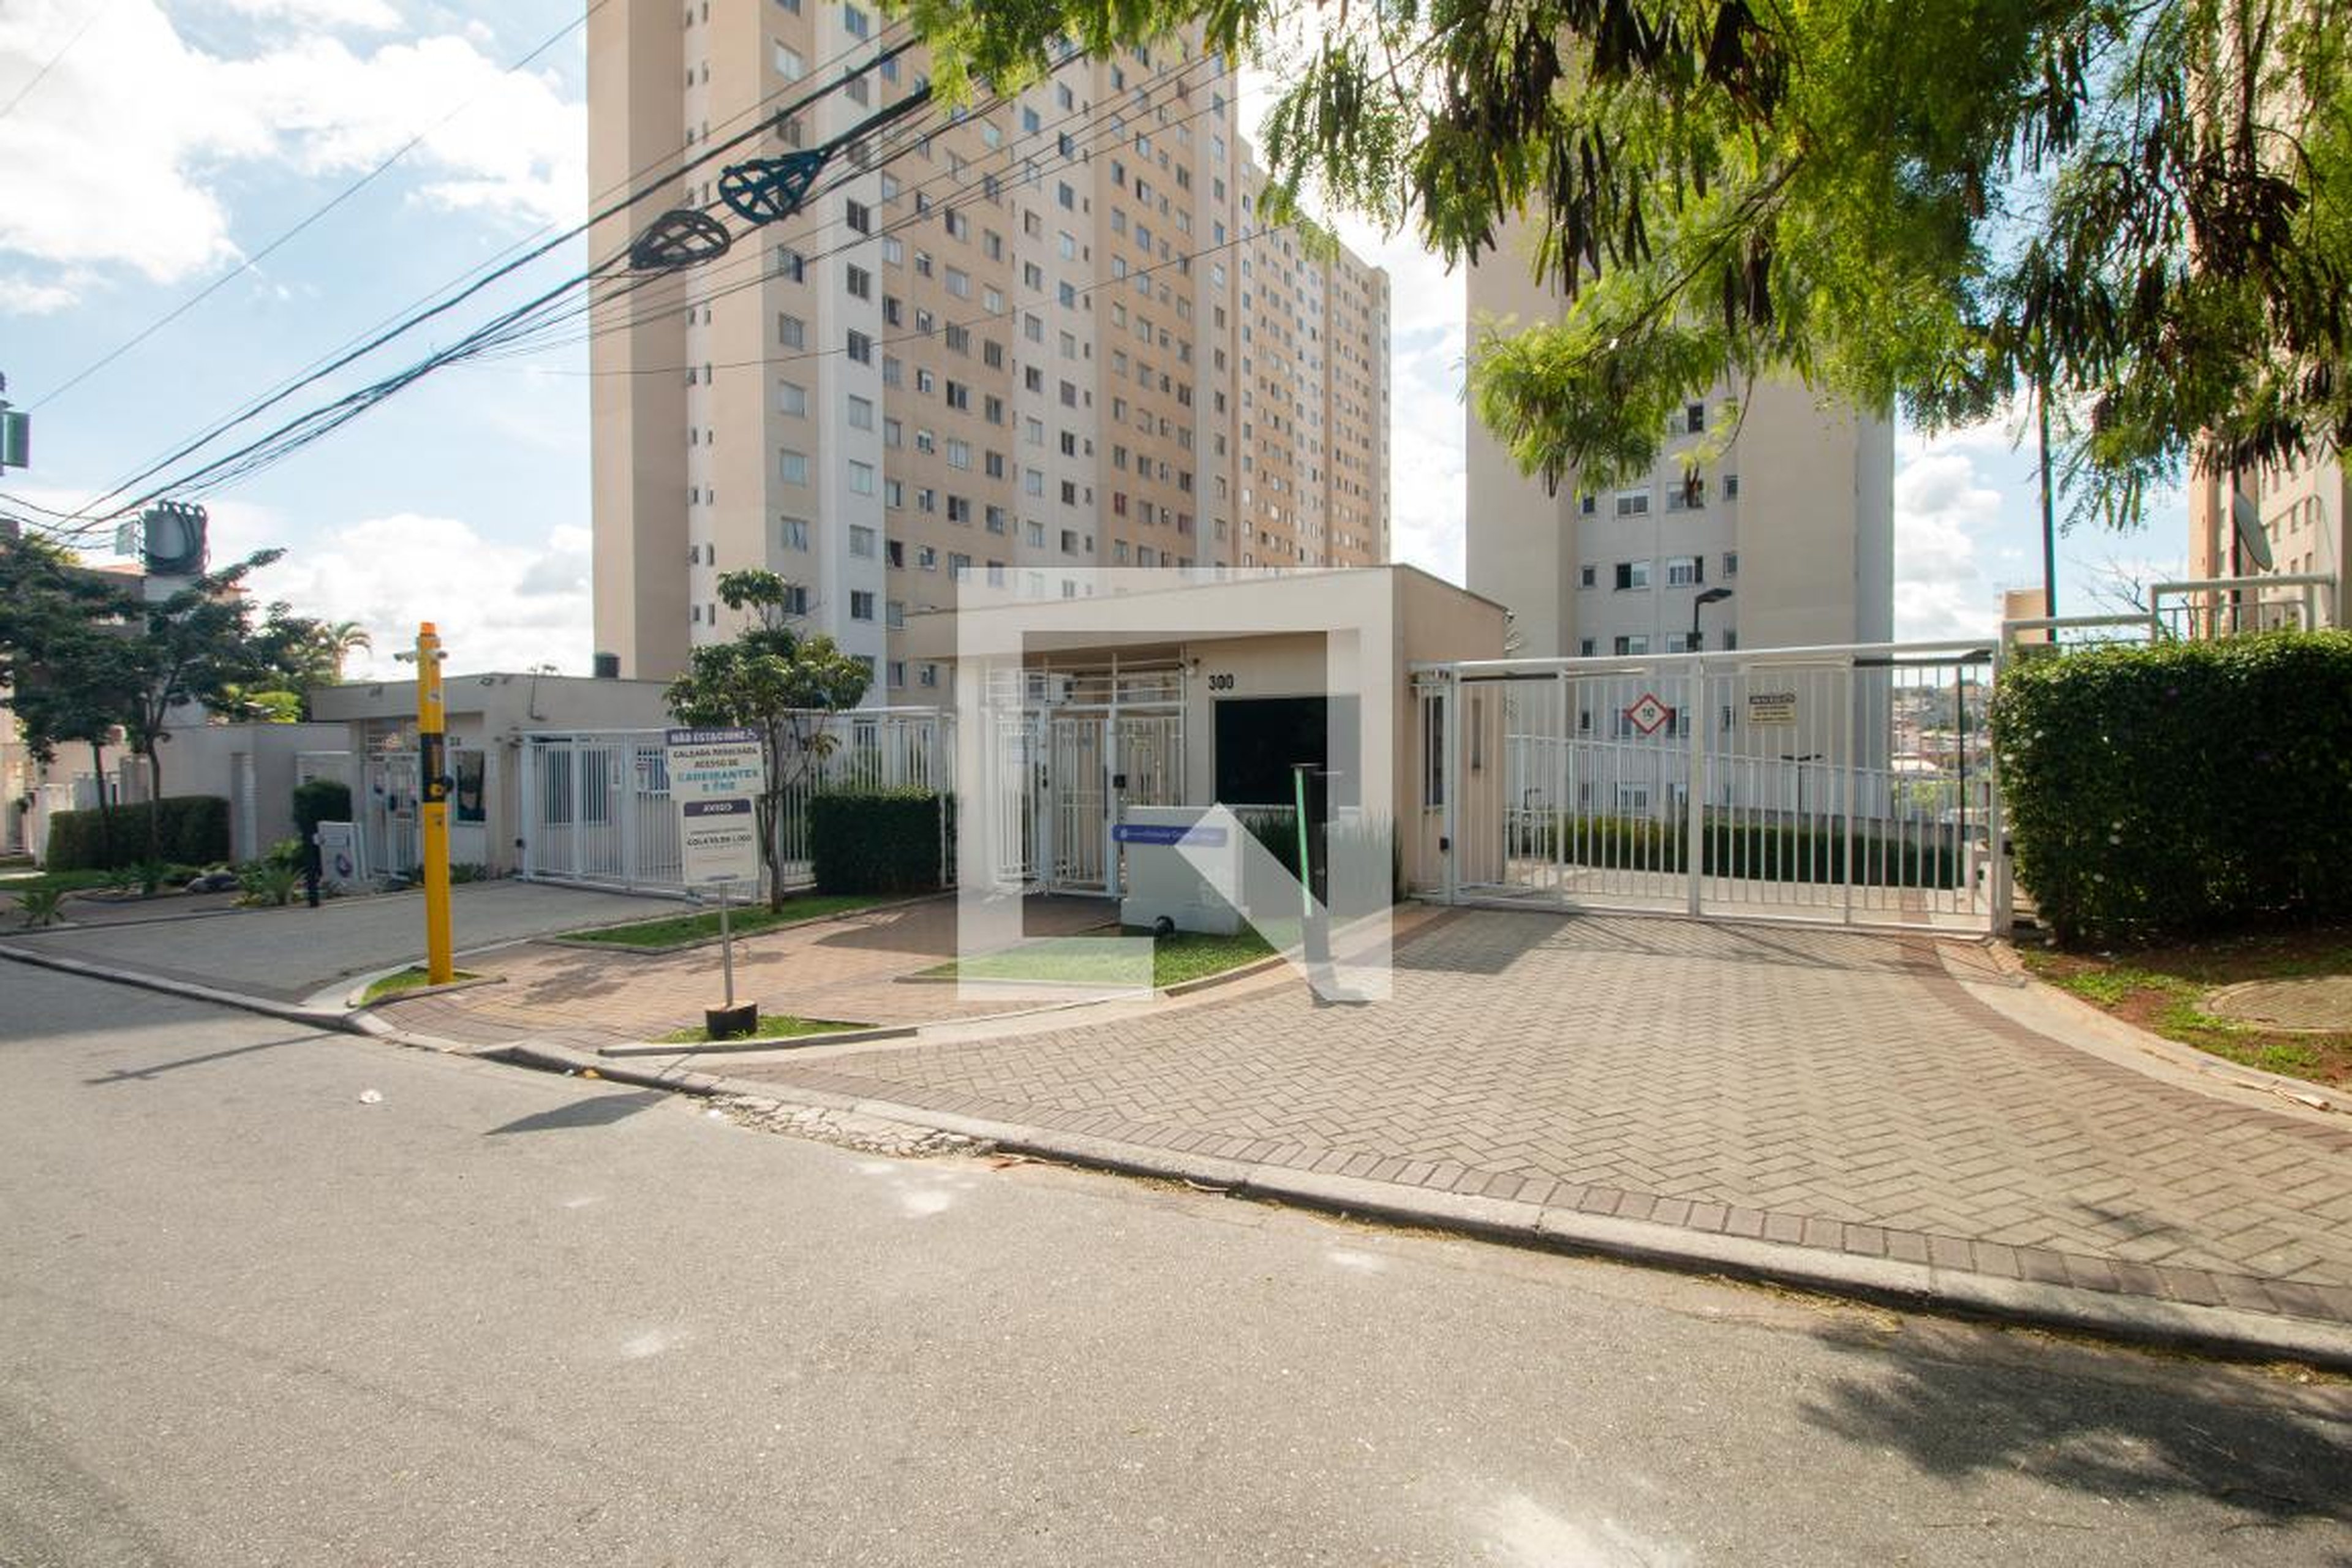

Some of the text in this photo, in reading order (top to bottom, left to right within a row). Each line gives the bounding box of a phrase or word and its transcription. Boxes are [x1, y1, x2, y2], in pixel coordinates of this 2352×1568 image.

[1208, 674, 1234, 690] 300
[671, 729, 745, 743] NÃO ESTACIONE
[695, 759, 726, 768] ACESSO
[677, 769, 758, 782] CADEIRANTES
